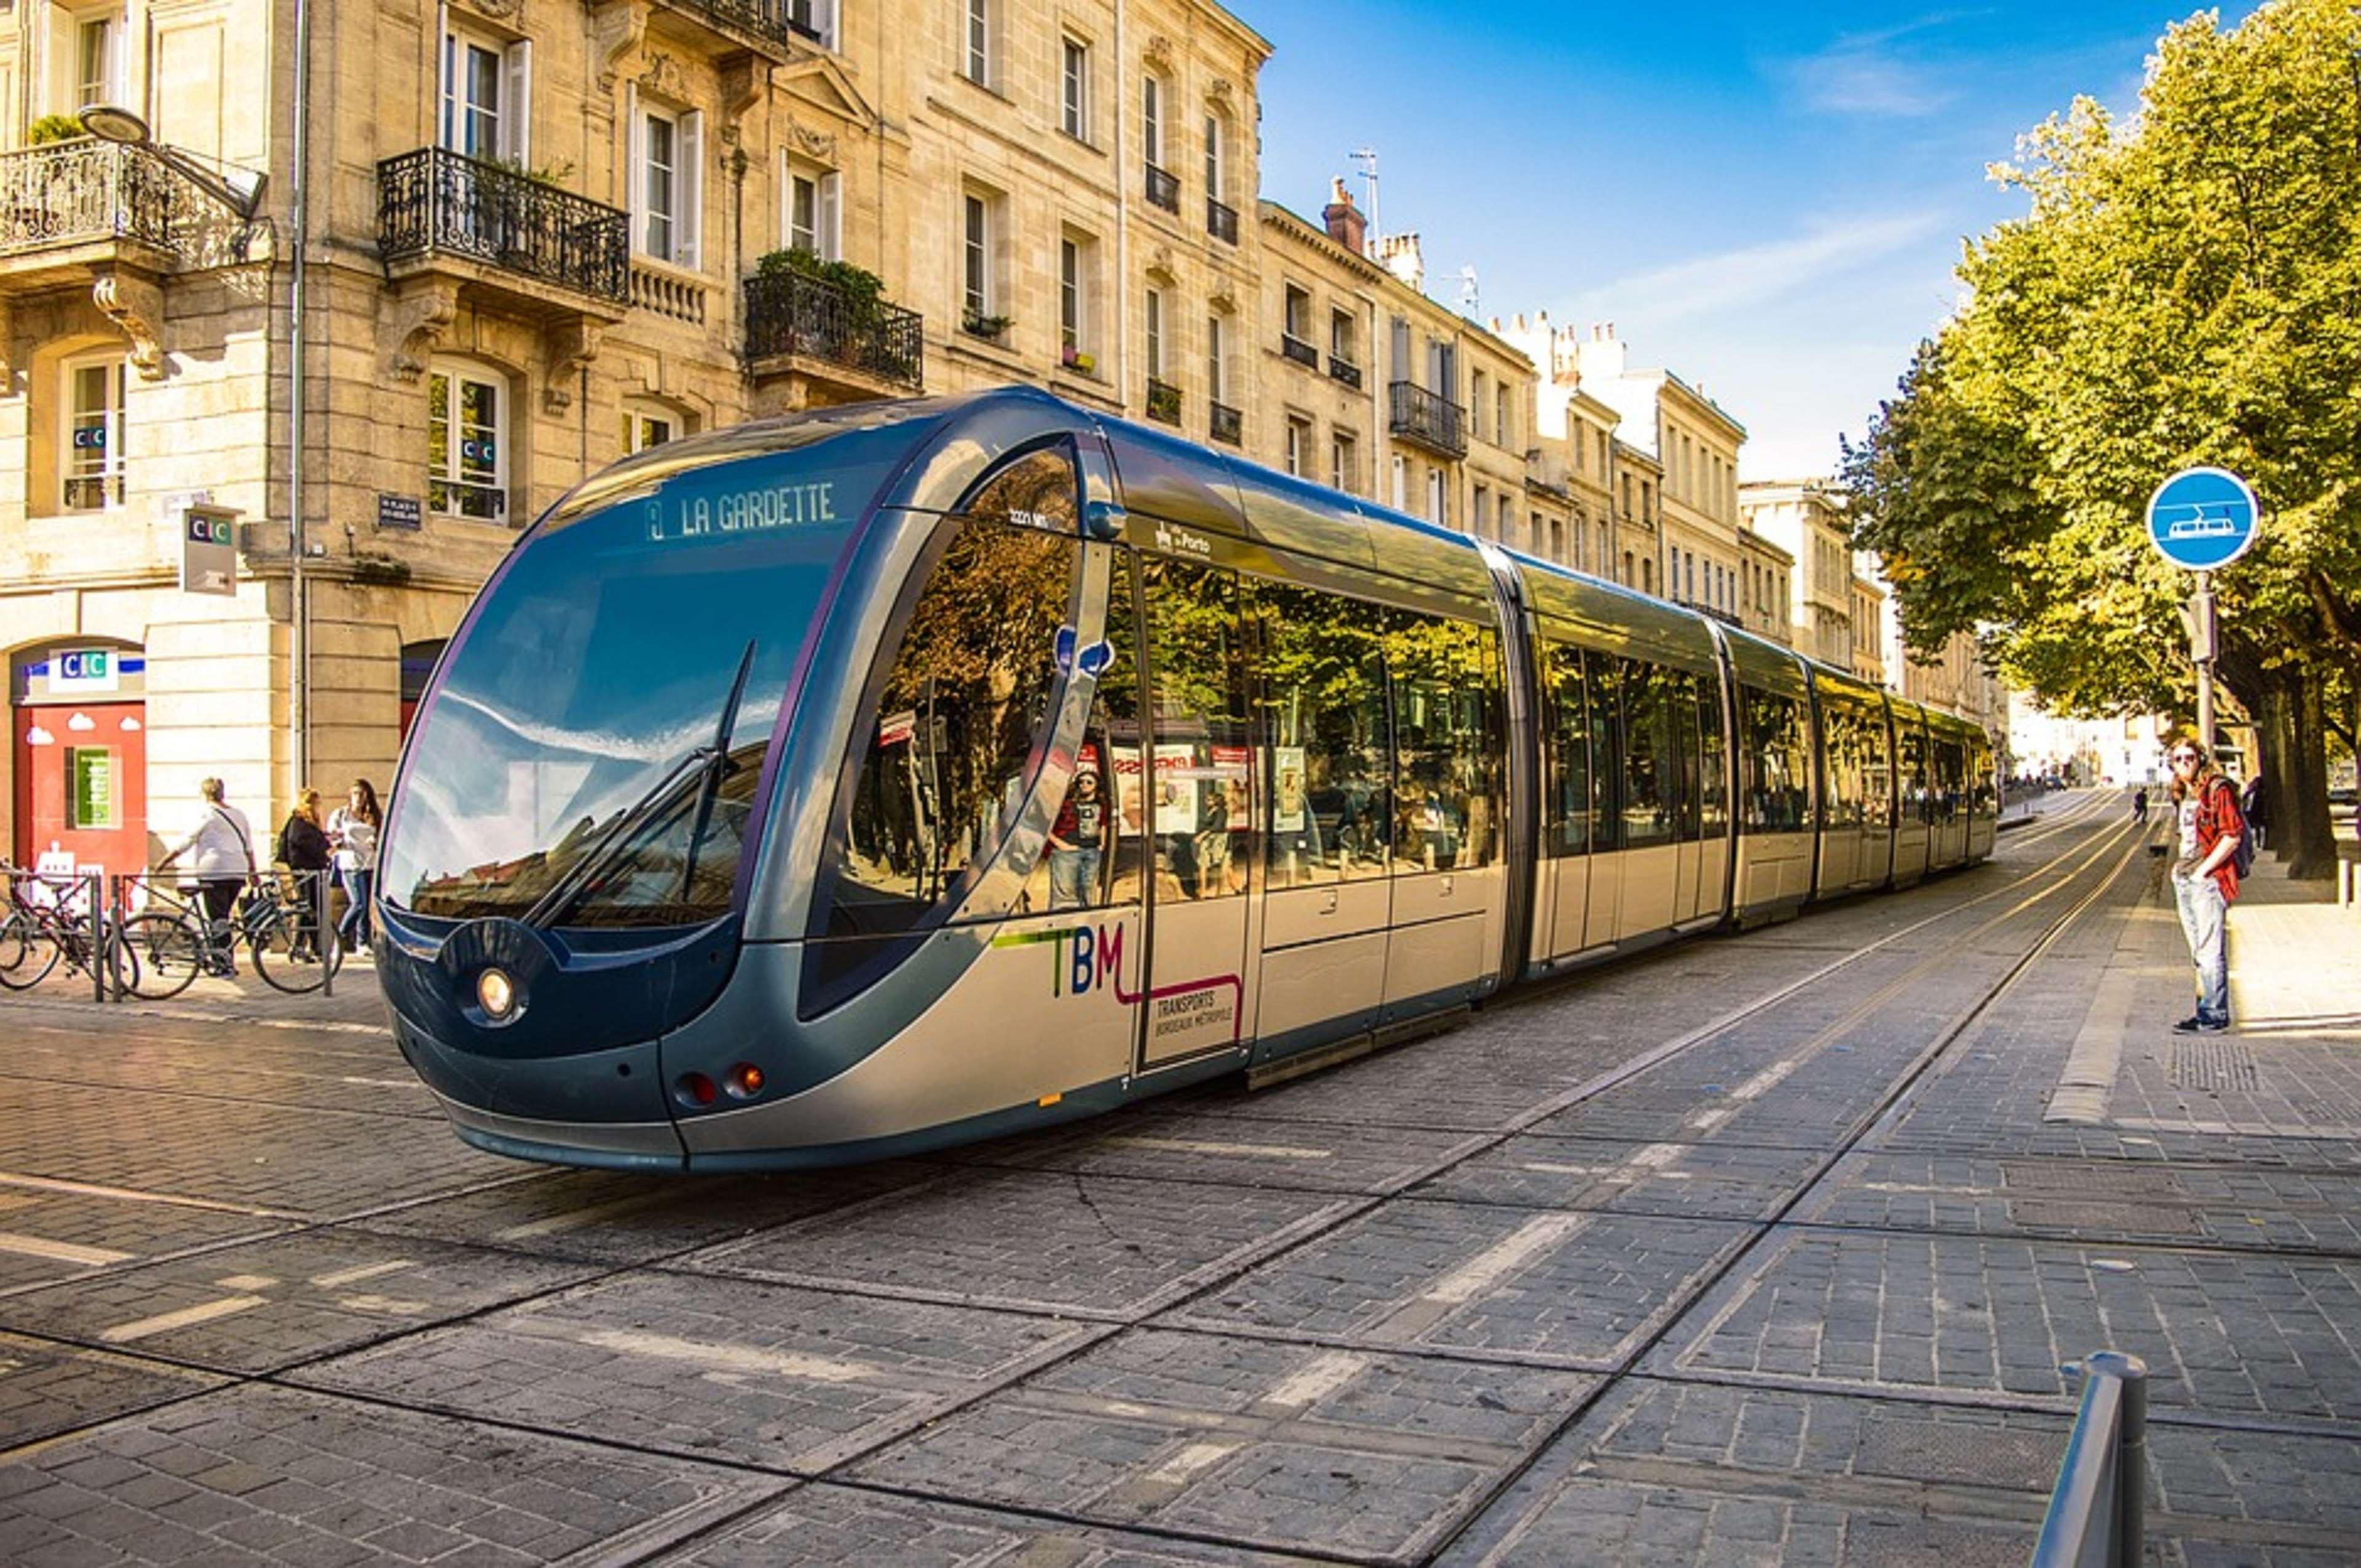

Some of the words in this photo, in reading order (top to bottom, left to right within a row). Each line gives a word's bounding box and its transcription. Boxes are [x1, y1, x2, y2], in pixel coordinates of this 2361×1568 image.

[76, 429, 104, 446] CIC
[682, 498, 709, 534] LA
[719, 483, 835, 531] GARDETTE
[193, 519, 227, 541] CIC
[64, 653, 105, 677] CIC
[1040, 921, 1126, 999] TBM
[1158, 990, 1215, 1018] TRANSPORTS
